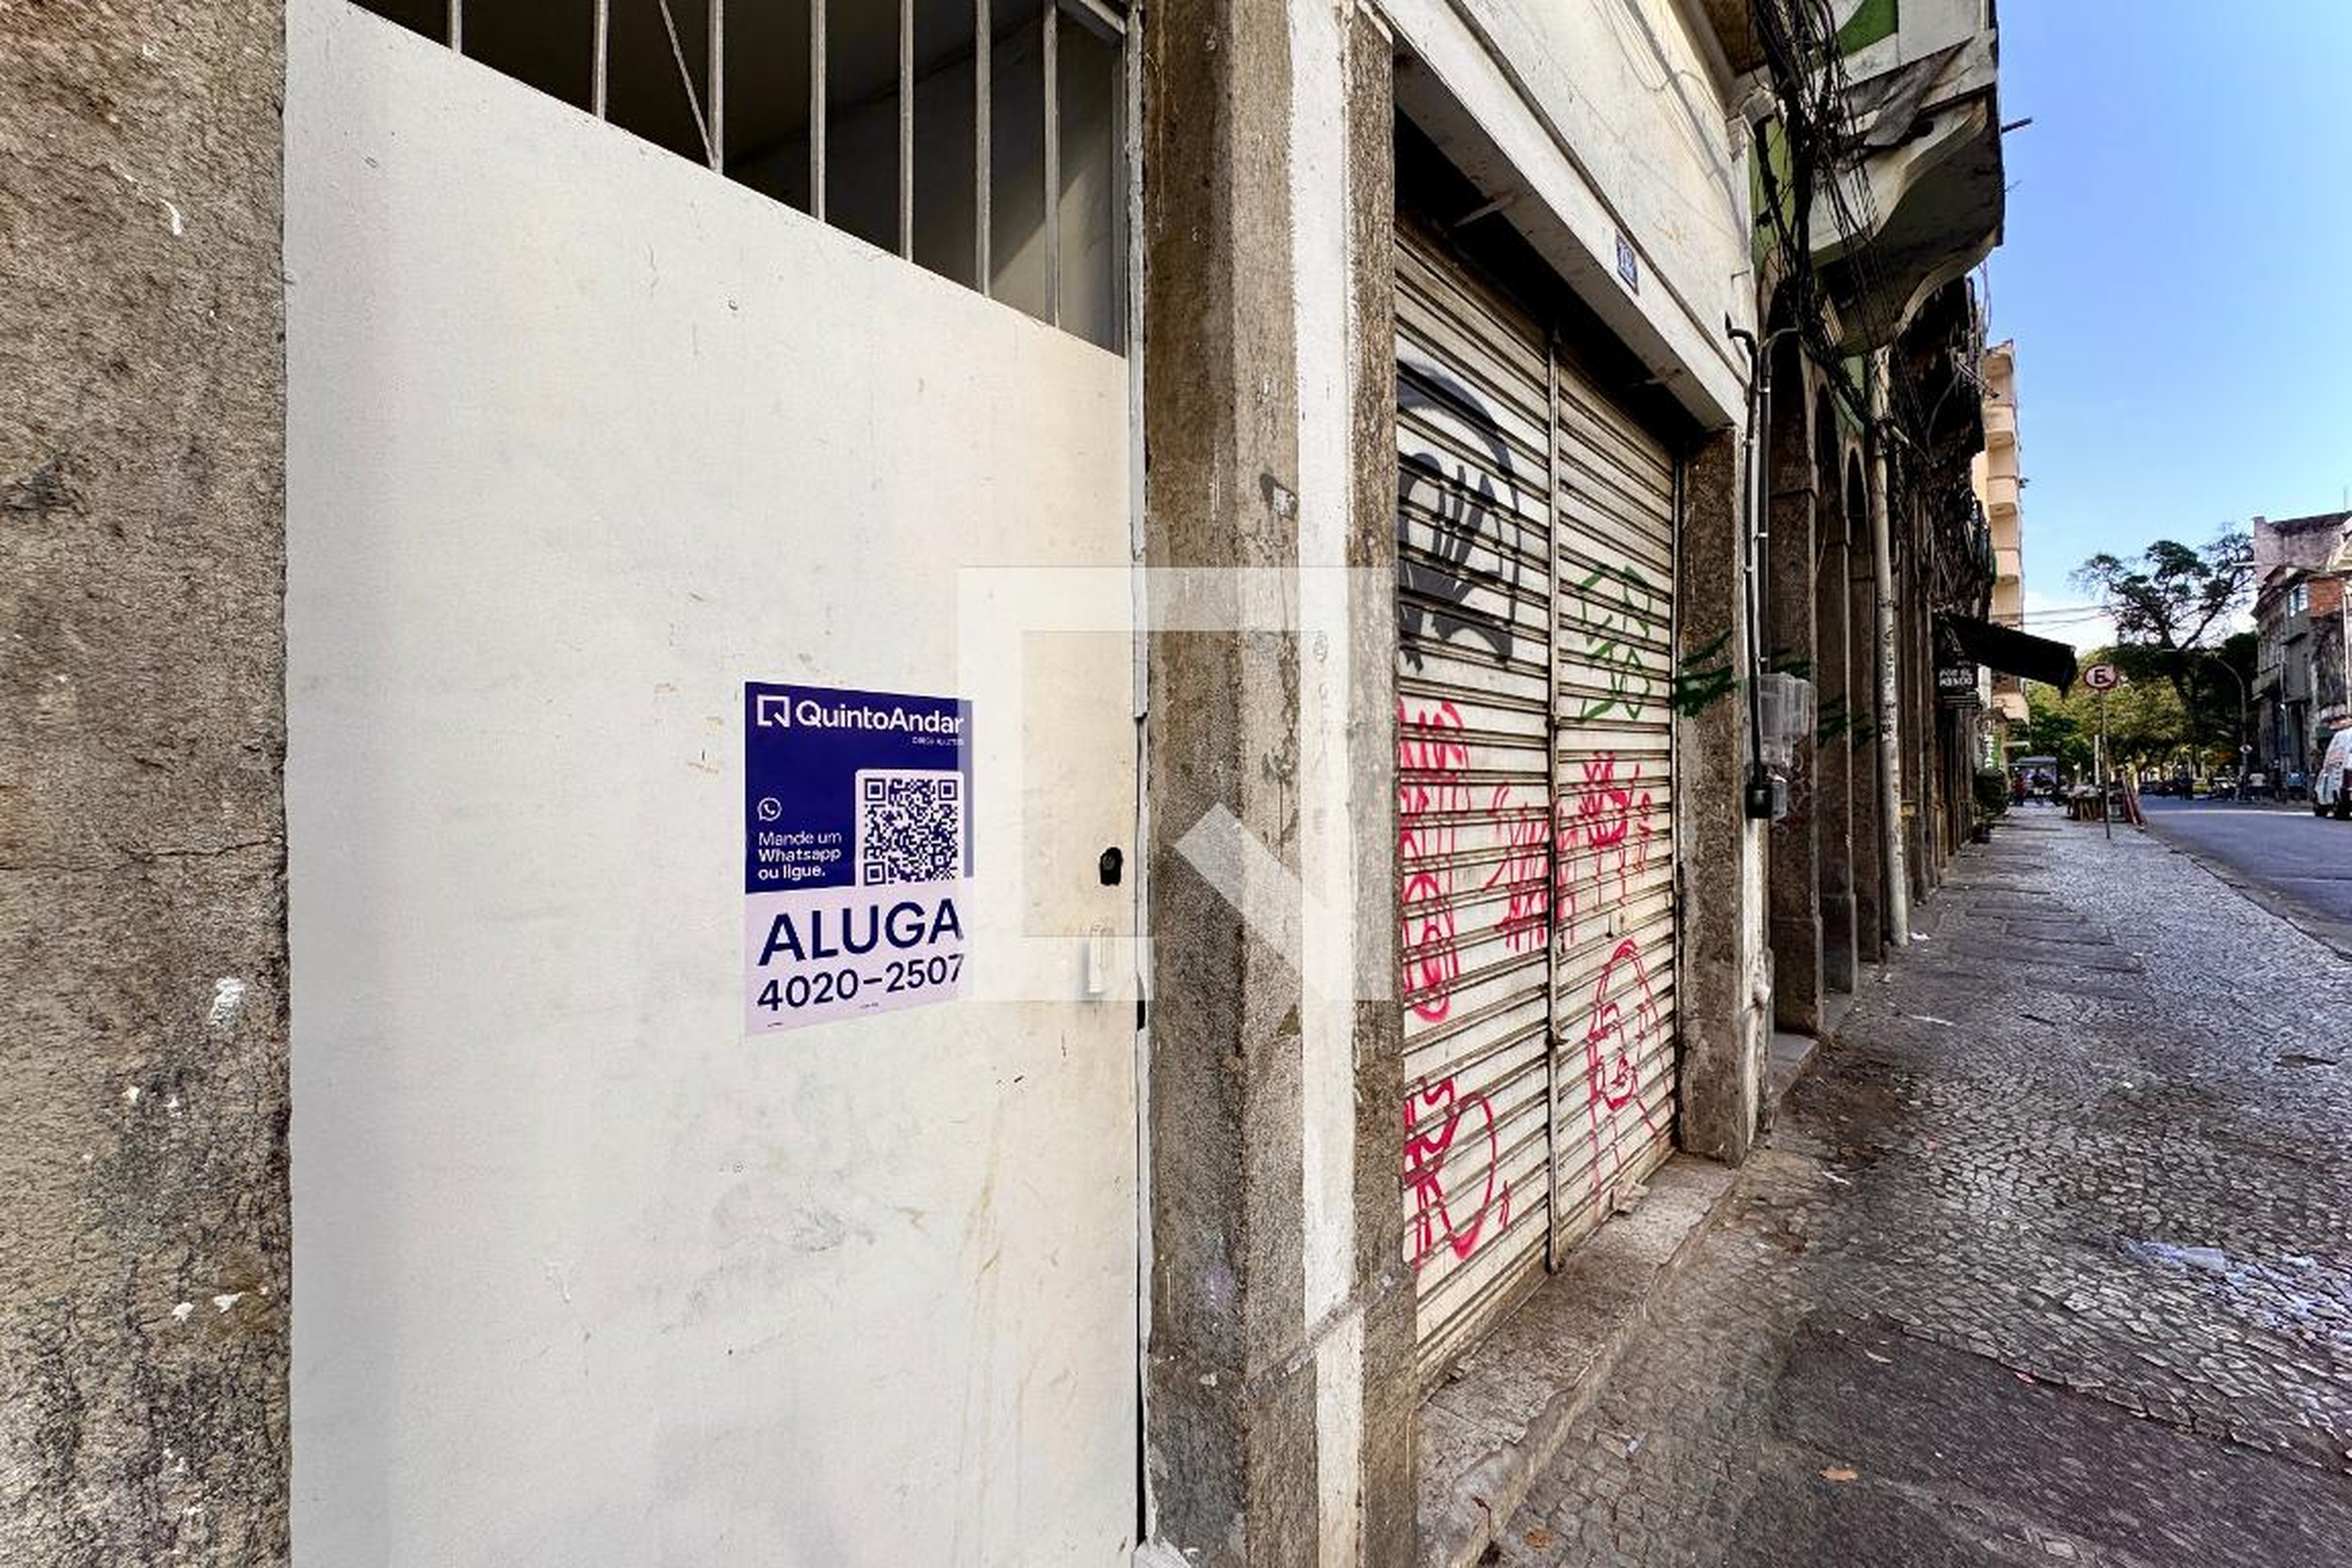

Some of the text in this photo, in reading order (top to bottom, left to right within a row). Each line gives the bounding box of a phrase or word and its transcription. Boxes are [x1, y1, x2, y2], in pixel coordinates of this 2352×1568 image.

[796, 700, 965, 734] QuintoAndar
[758, 830, 842, 846] Mande um
[758, 848, 842, 863] Whatsapp
[758, 863, 826, 881] ou ligue.
[757, 898, 965, 967] ALUGA
[757, 953, 965, 1011] 4020-2507
